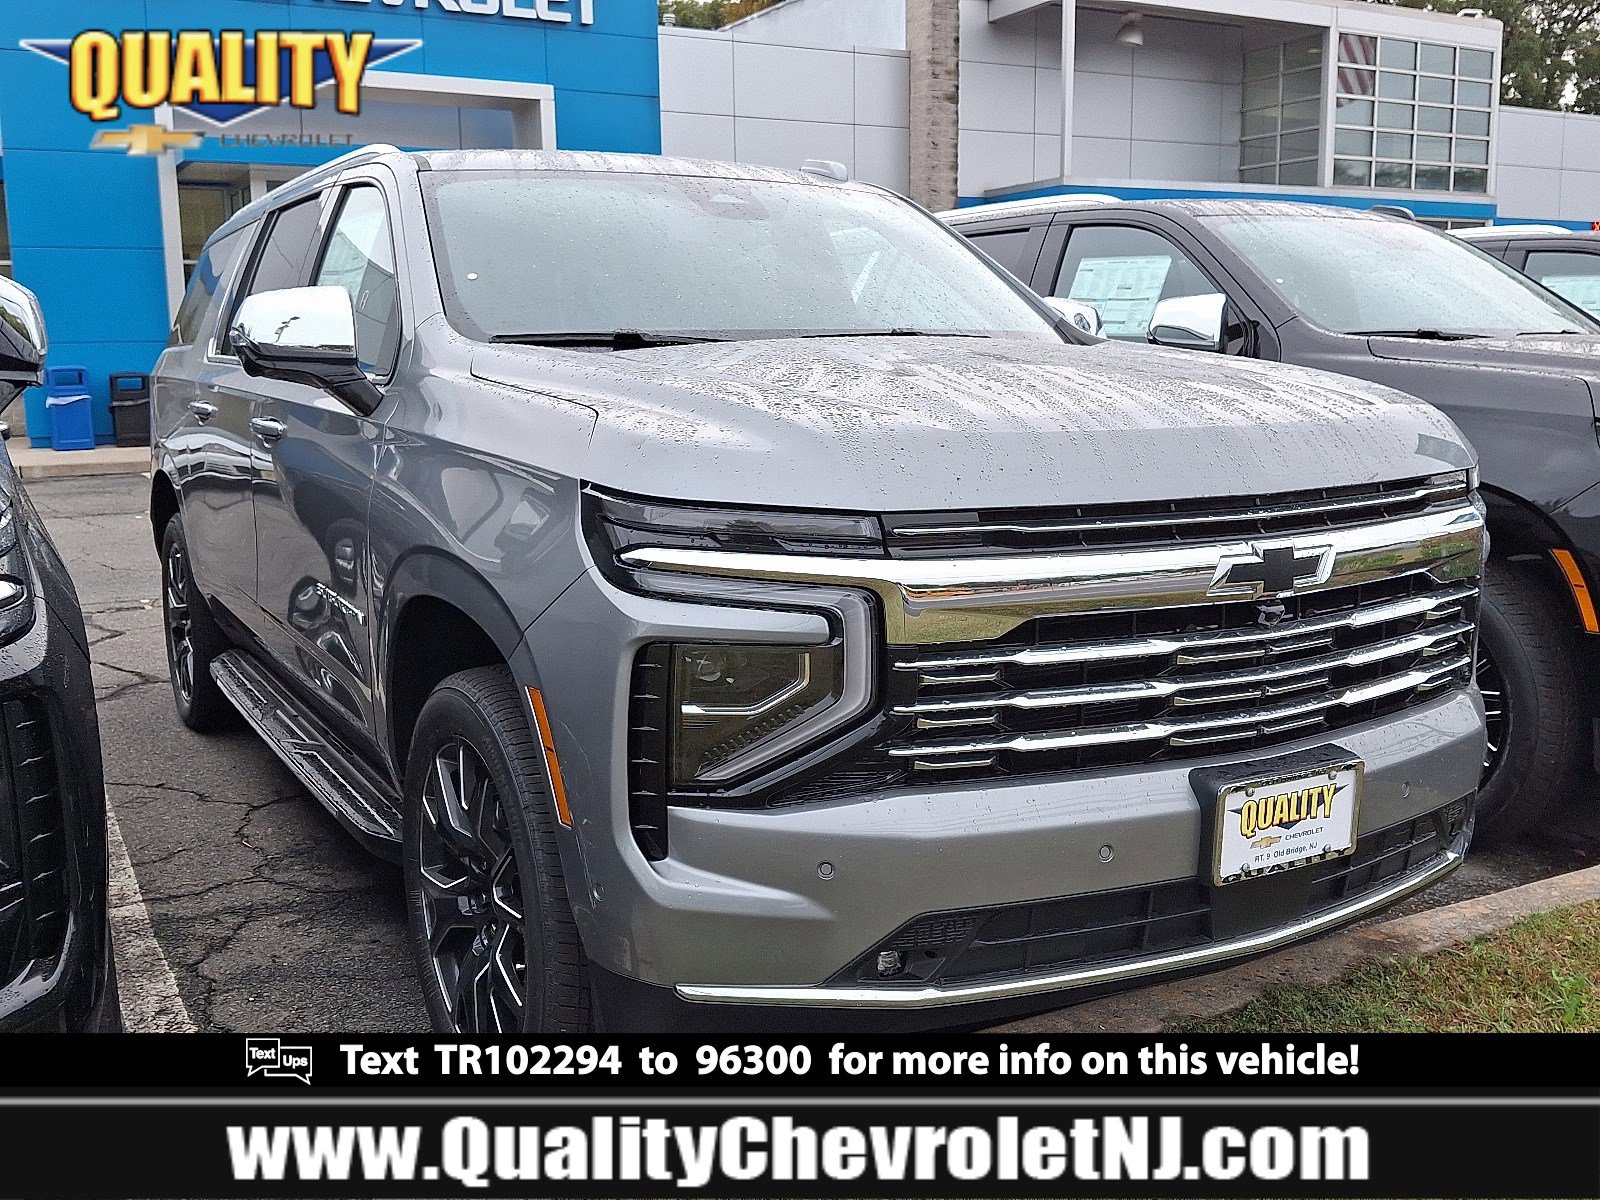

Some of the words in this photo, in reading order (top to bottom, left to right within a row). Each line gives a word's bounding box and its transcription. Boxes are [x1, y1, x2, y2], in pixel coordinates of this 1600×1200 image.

[1240, 783, 1337, 839] QUALITY
[1284, 826, 1323, 841] CHEVROLET
[1273, 848, 1285, 858] Old
[1286, 844, 1308, 856] Bridge,
[1309, 842, 1318, 850] NJ
